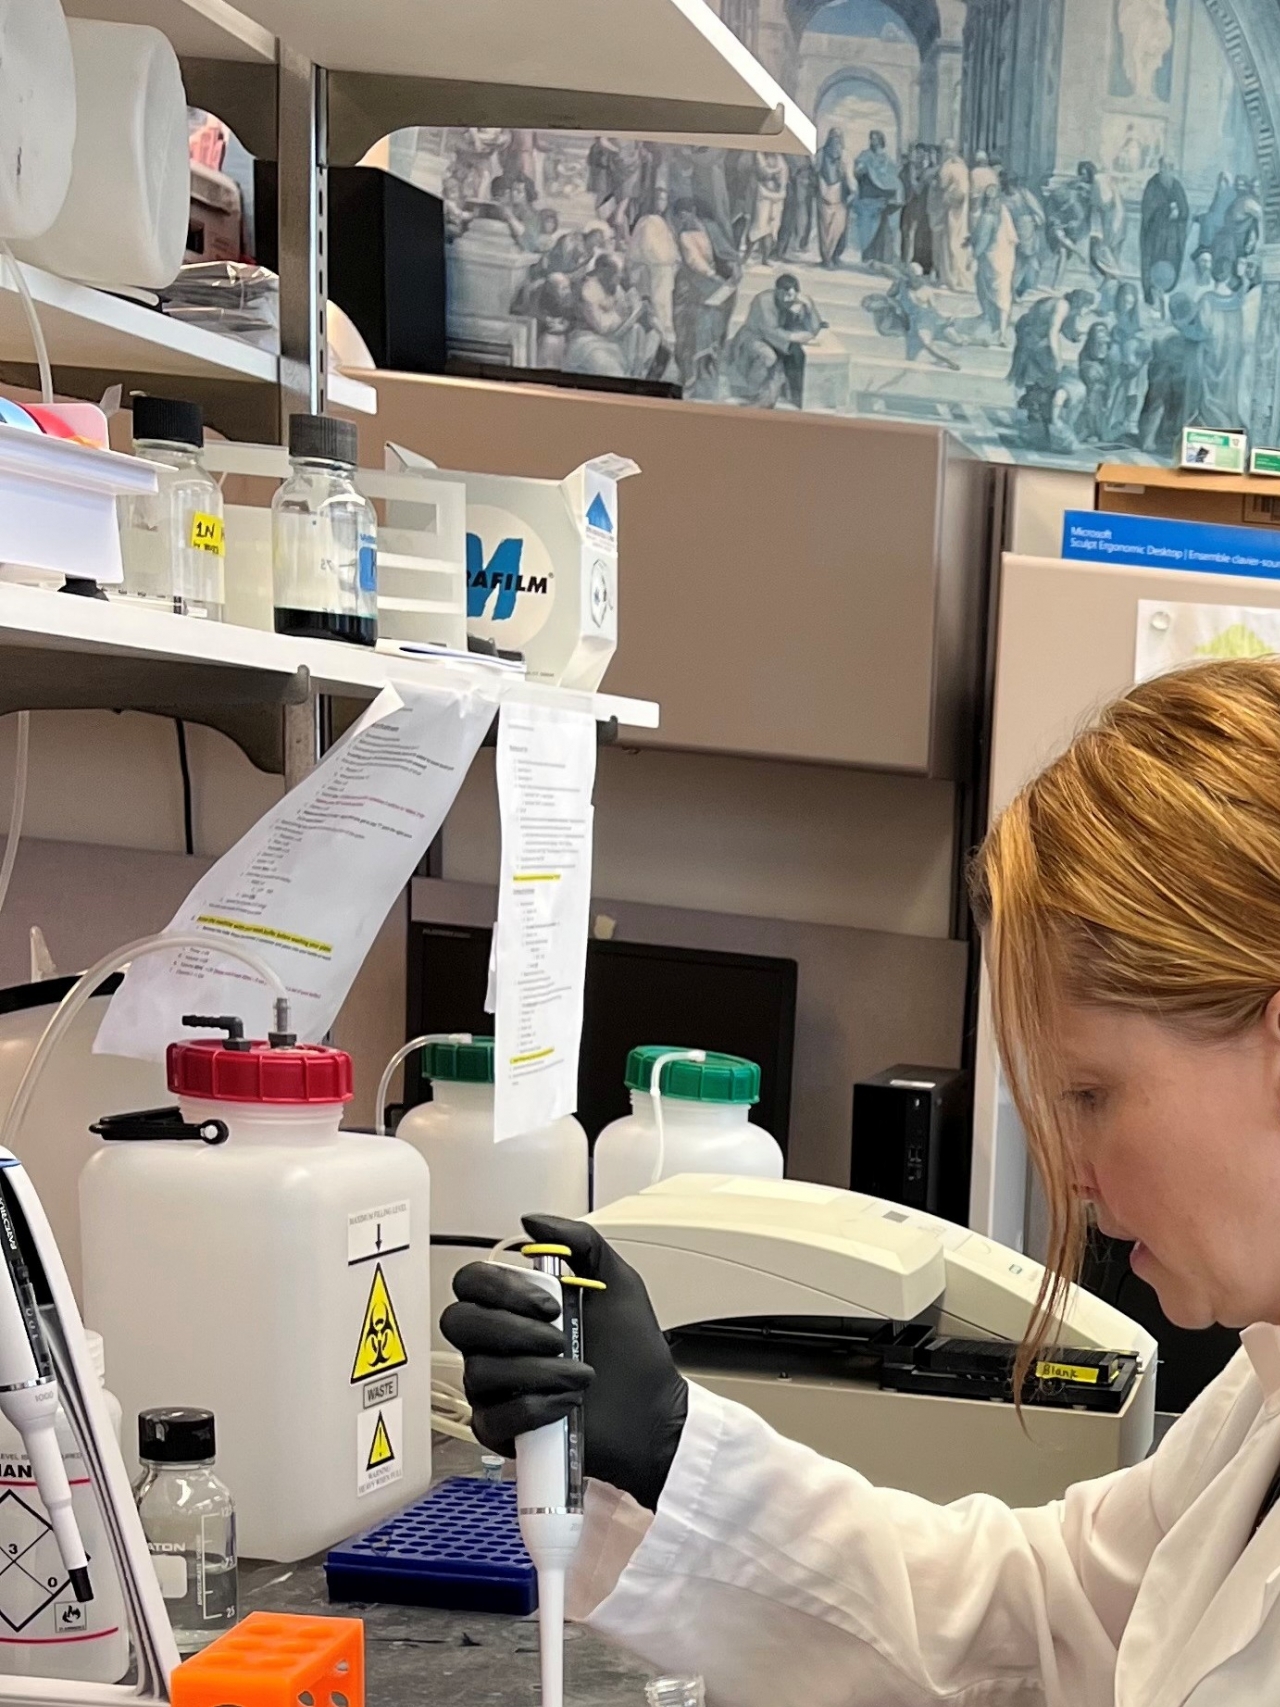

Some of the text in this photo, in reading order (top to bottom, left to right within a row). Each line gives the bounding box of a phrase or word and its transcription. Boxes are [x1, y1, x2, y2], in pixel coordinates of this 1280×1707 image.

[1070, 526, 1112, 540] Microsoft
[1070, 537, 1098, 551] Sculpt
[1098, 540, 1145, 554] Ergonomic
[1146, 544, 1183, 560] Desktop
[1188, 549, 1231, 563] Ensemble
[466, 568, 549, 594] AFILM
[571, 1317, 580, 1363] RTORIUS
[1043, 1364, 1078, 1379] Blank
[34, 1392, 54, 1402] 1000
[366, 1382, 394, 1402] WASTE
[8, 1543, 18, 1555] 3
[147, 1542, 186, 1552] ATON
[47, 1577, 58, 1588] 0
[225, 1605, 236, 1619] 25
